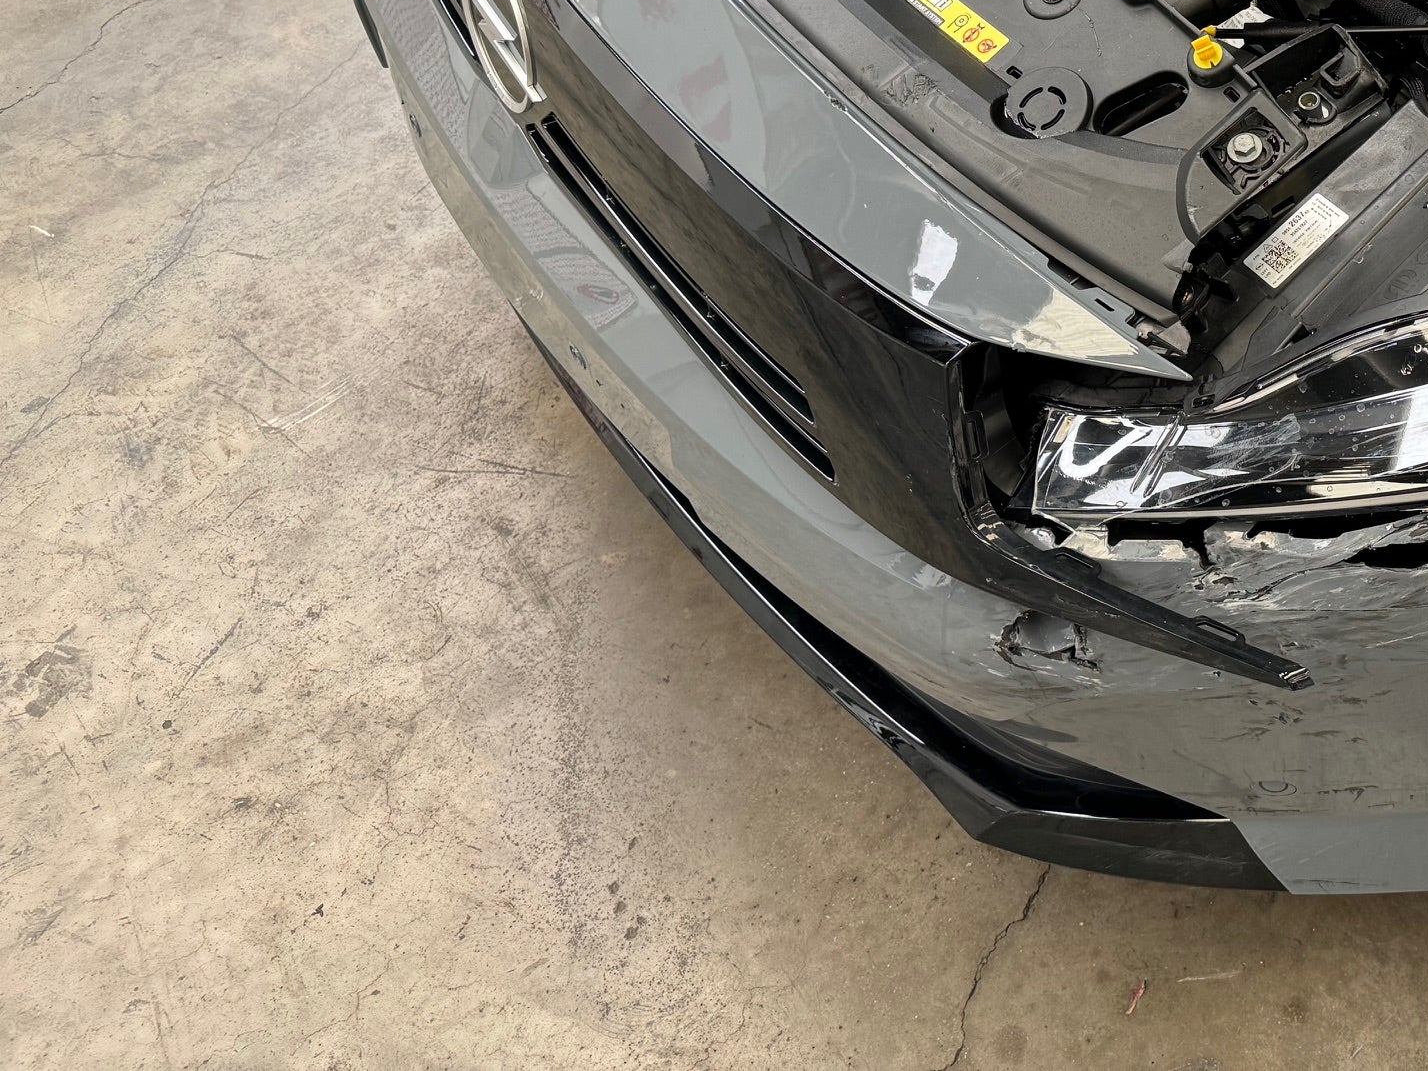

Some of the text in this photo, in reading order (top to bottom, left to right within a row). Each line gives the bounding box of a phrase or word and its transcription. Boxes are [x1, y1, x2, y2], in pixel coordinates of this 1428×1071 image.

[912, 0, 928, 12] START
[924, 9, 942, 25] SYSTEM
[1287, 211, 1305, 227] 2637
